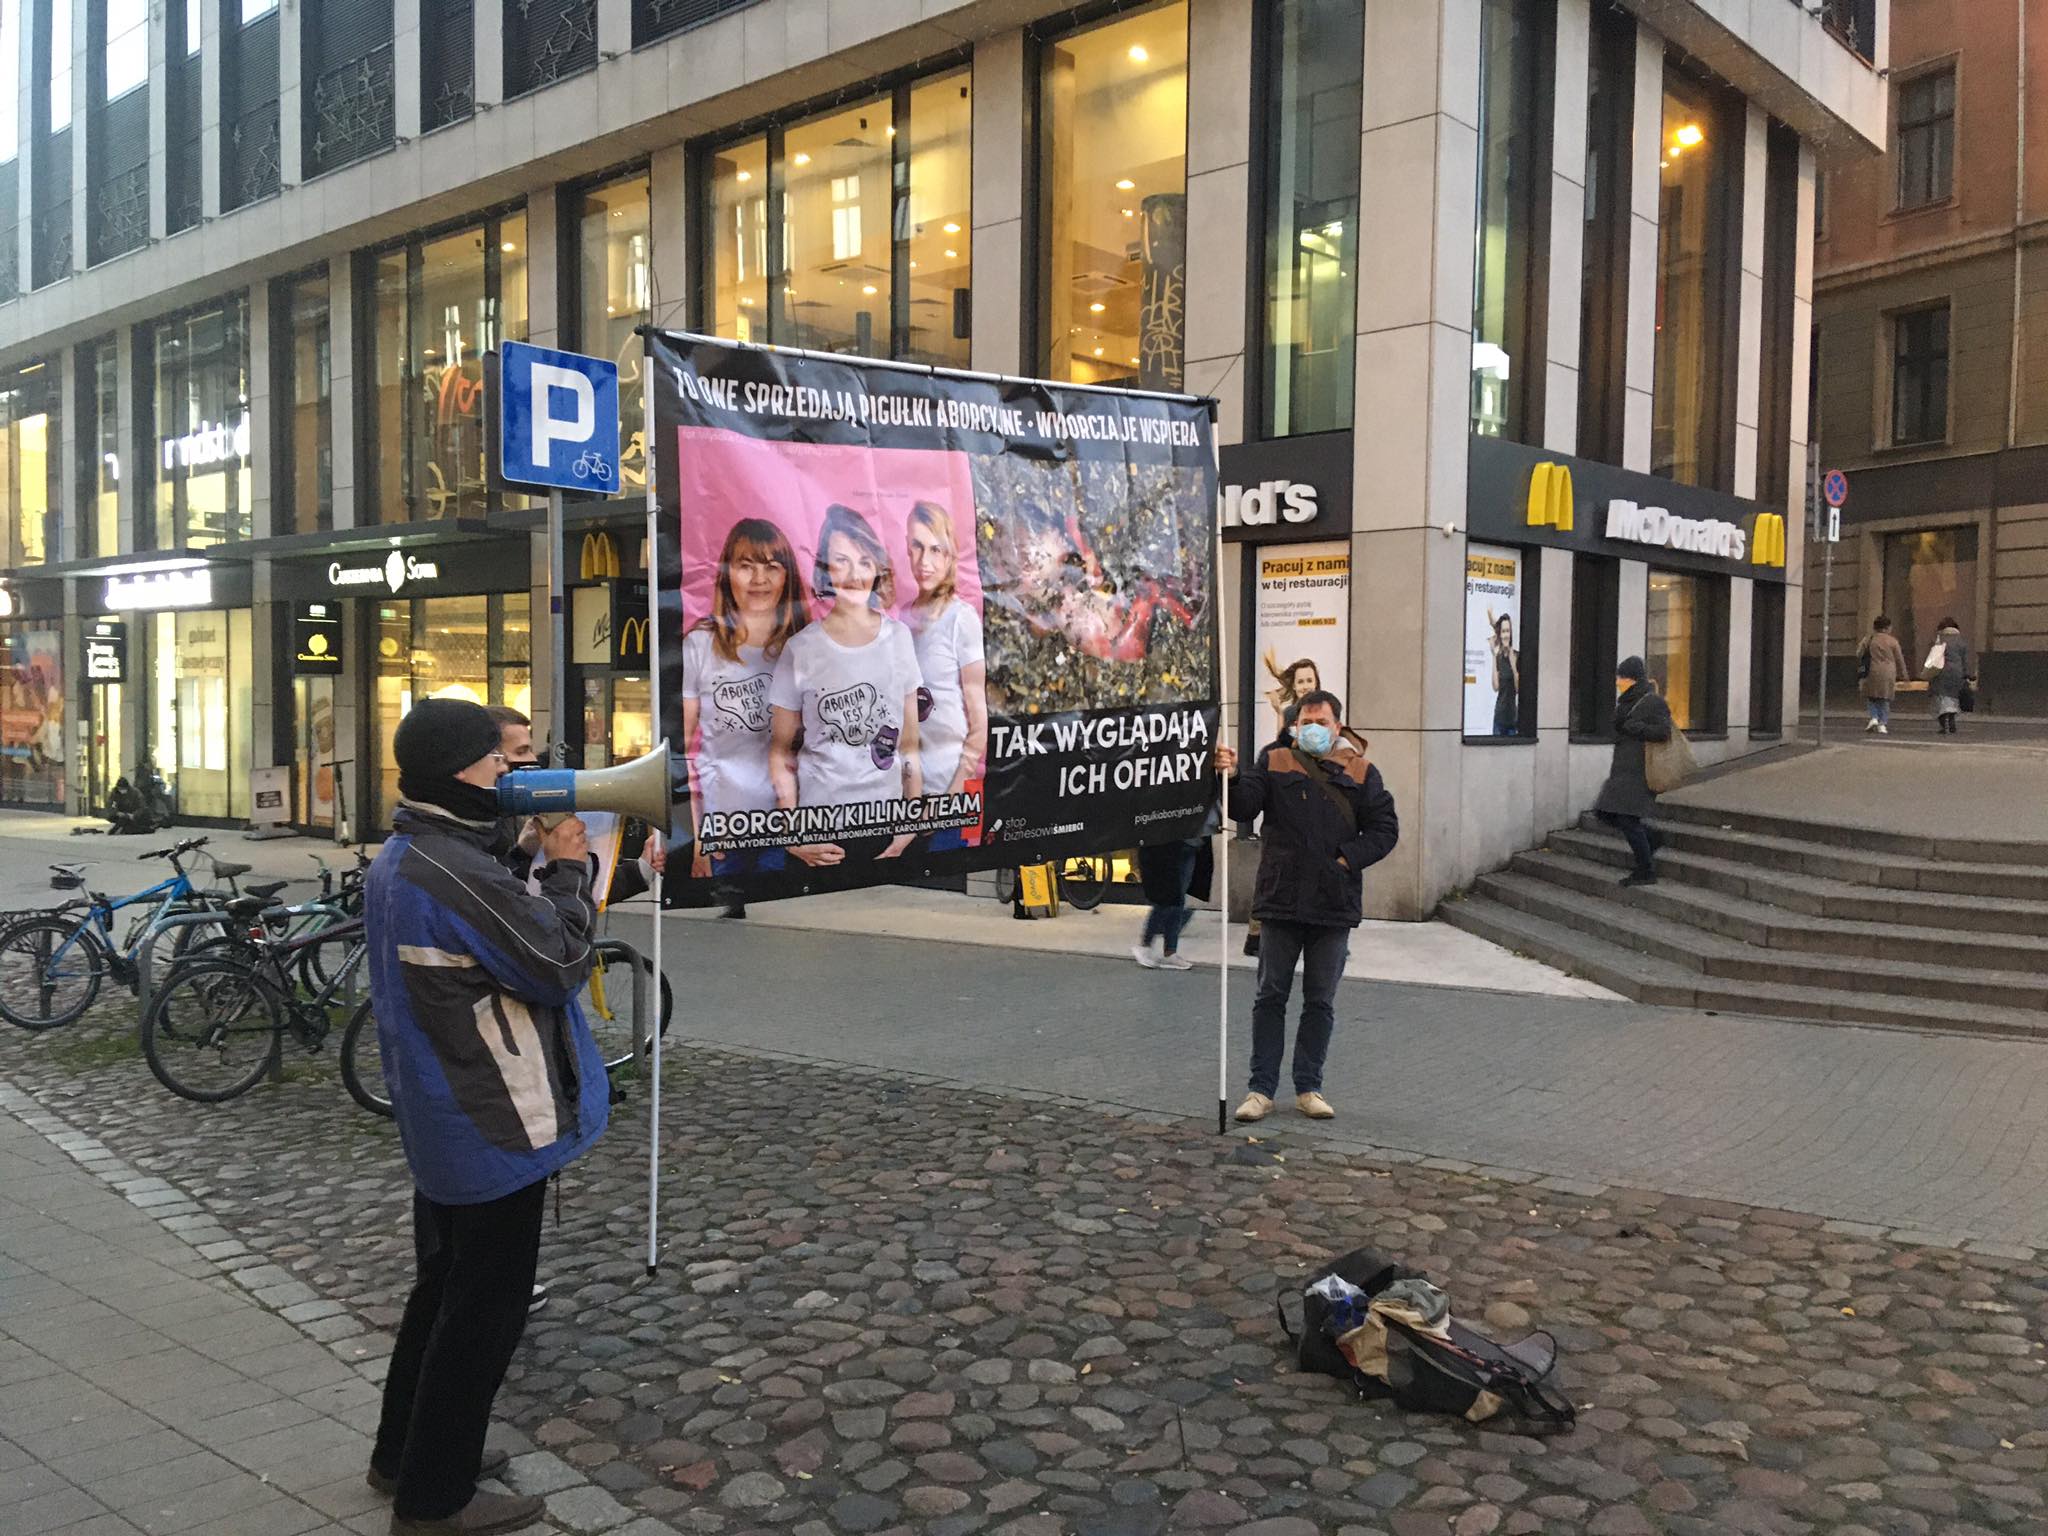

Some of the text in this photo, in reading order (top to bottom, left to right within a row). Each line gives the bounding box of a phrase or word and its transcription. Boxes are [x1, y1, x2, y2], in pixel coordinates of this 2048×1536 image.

[531, 362, 595, 467] P
[672, 367, 699, 399] TO
[697, 376, 738, 411] ONE
[744, 382, 857, 427] SPRZEDAJĄ
[860, 394, 931, 427] PIGUŁKI
[937, 399, 1025, 436] ABORCYJNE
[1121, 417, 1138, 442] JE
[1139, 420, 1200, 447] WSPIERA
[1220, 480, 1318, 526] ld's
[1605, 499, 1746, 560] McDonald's
[1261, 582, 1271, 590] w
[1272, 578, 1287, 592] tej
[1263, 556, 1349, 575] Pracuj z nami
[1487, 562, 1493, 574] z
[1493, 560, 1516, 577] nami
[748, 710, 765, 725] OK
[991, 710, 1208, 758] TAK WYGLĄDAJĄ
[1059, 751, 1208, 797] ICH OFIARY
[700, 793, 981, 838] ABORCYJNY KILLING TEAM
[802, 832, 836, 844] NATALIA
[895, 821, 931, 833] KAROLINA
[1006, 817, 1027, 830] stop
